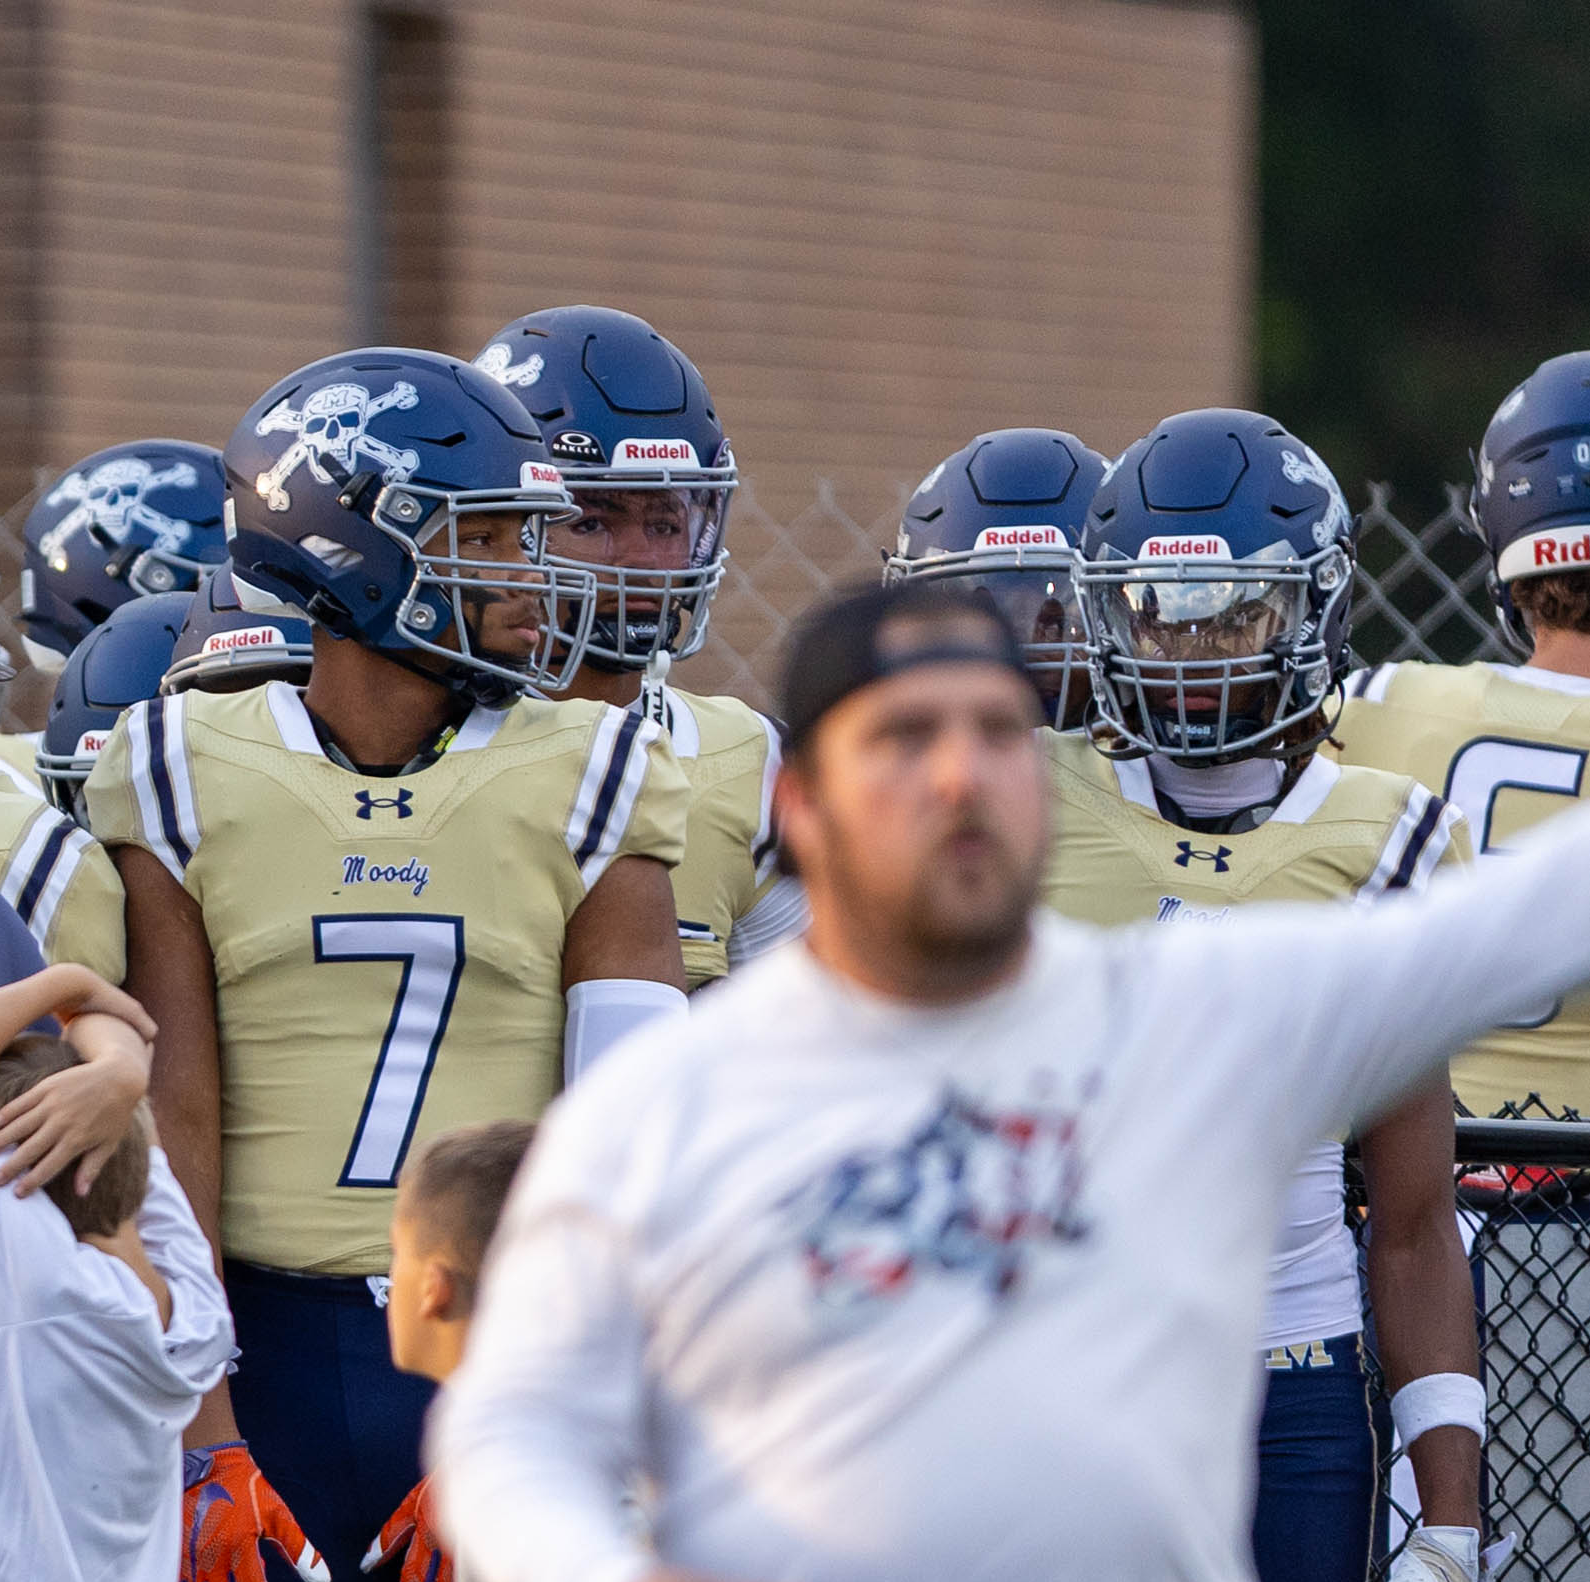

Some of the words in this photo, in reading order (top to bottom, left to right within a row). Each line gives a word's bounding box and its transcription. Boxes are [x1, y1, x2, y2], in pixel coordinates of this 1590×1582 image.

[552, 442, 599, 455] OAKLEY
[625, 444, 690, 459] Riddell
[985, 529, 1057, 547] Riddell
[1147, 540, 1220, 557] Riddell
[1533, 534, 1590, 567] Rid
[209, 630, 274, 651] Riddell
[341, 854, 430, 897] Moody
[311, 912, 466, 1188] 7
